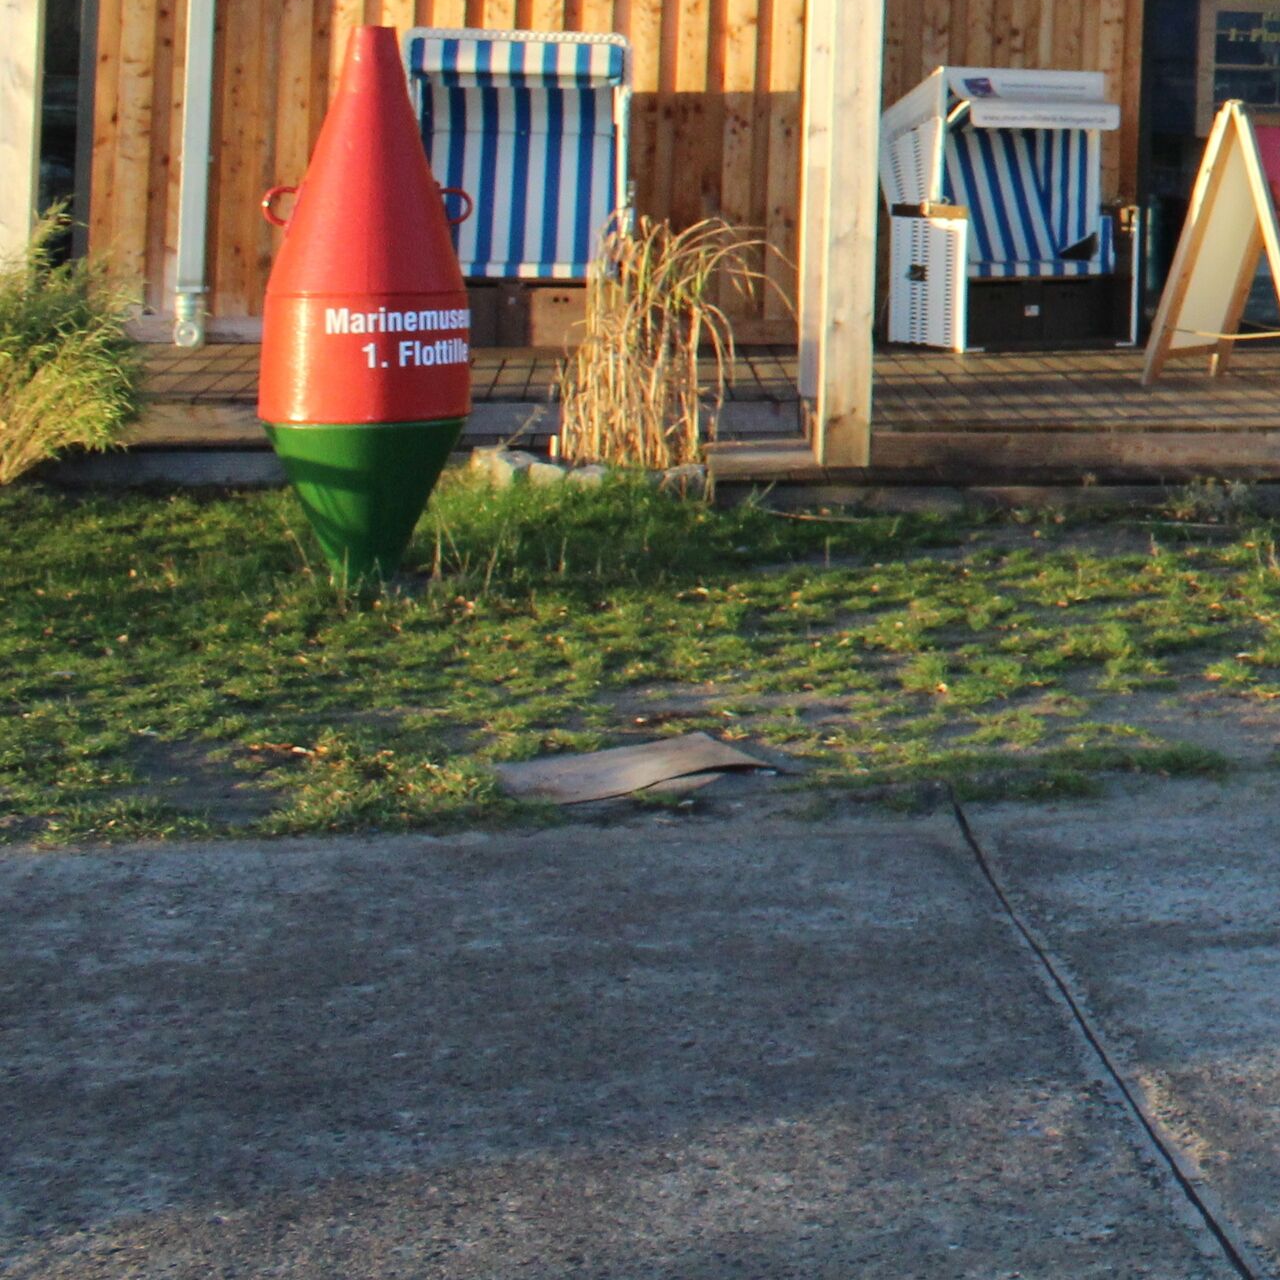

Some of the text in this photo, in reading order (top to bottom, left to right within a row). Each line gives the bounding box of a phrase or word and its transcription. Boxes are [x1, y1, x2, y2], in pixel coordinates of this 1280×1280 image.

[324, 307, 472, 335] Marinemuse
[361, 338, 469, 369] 1. Flottille
